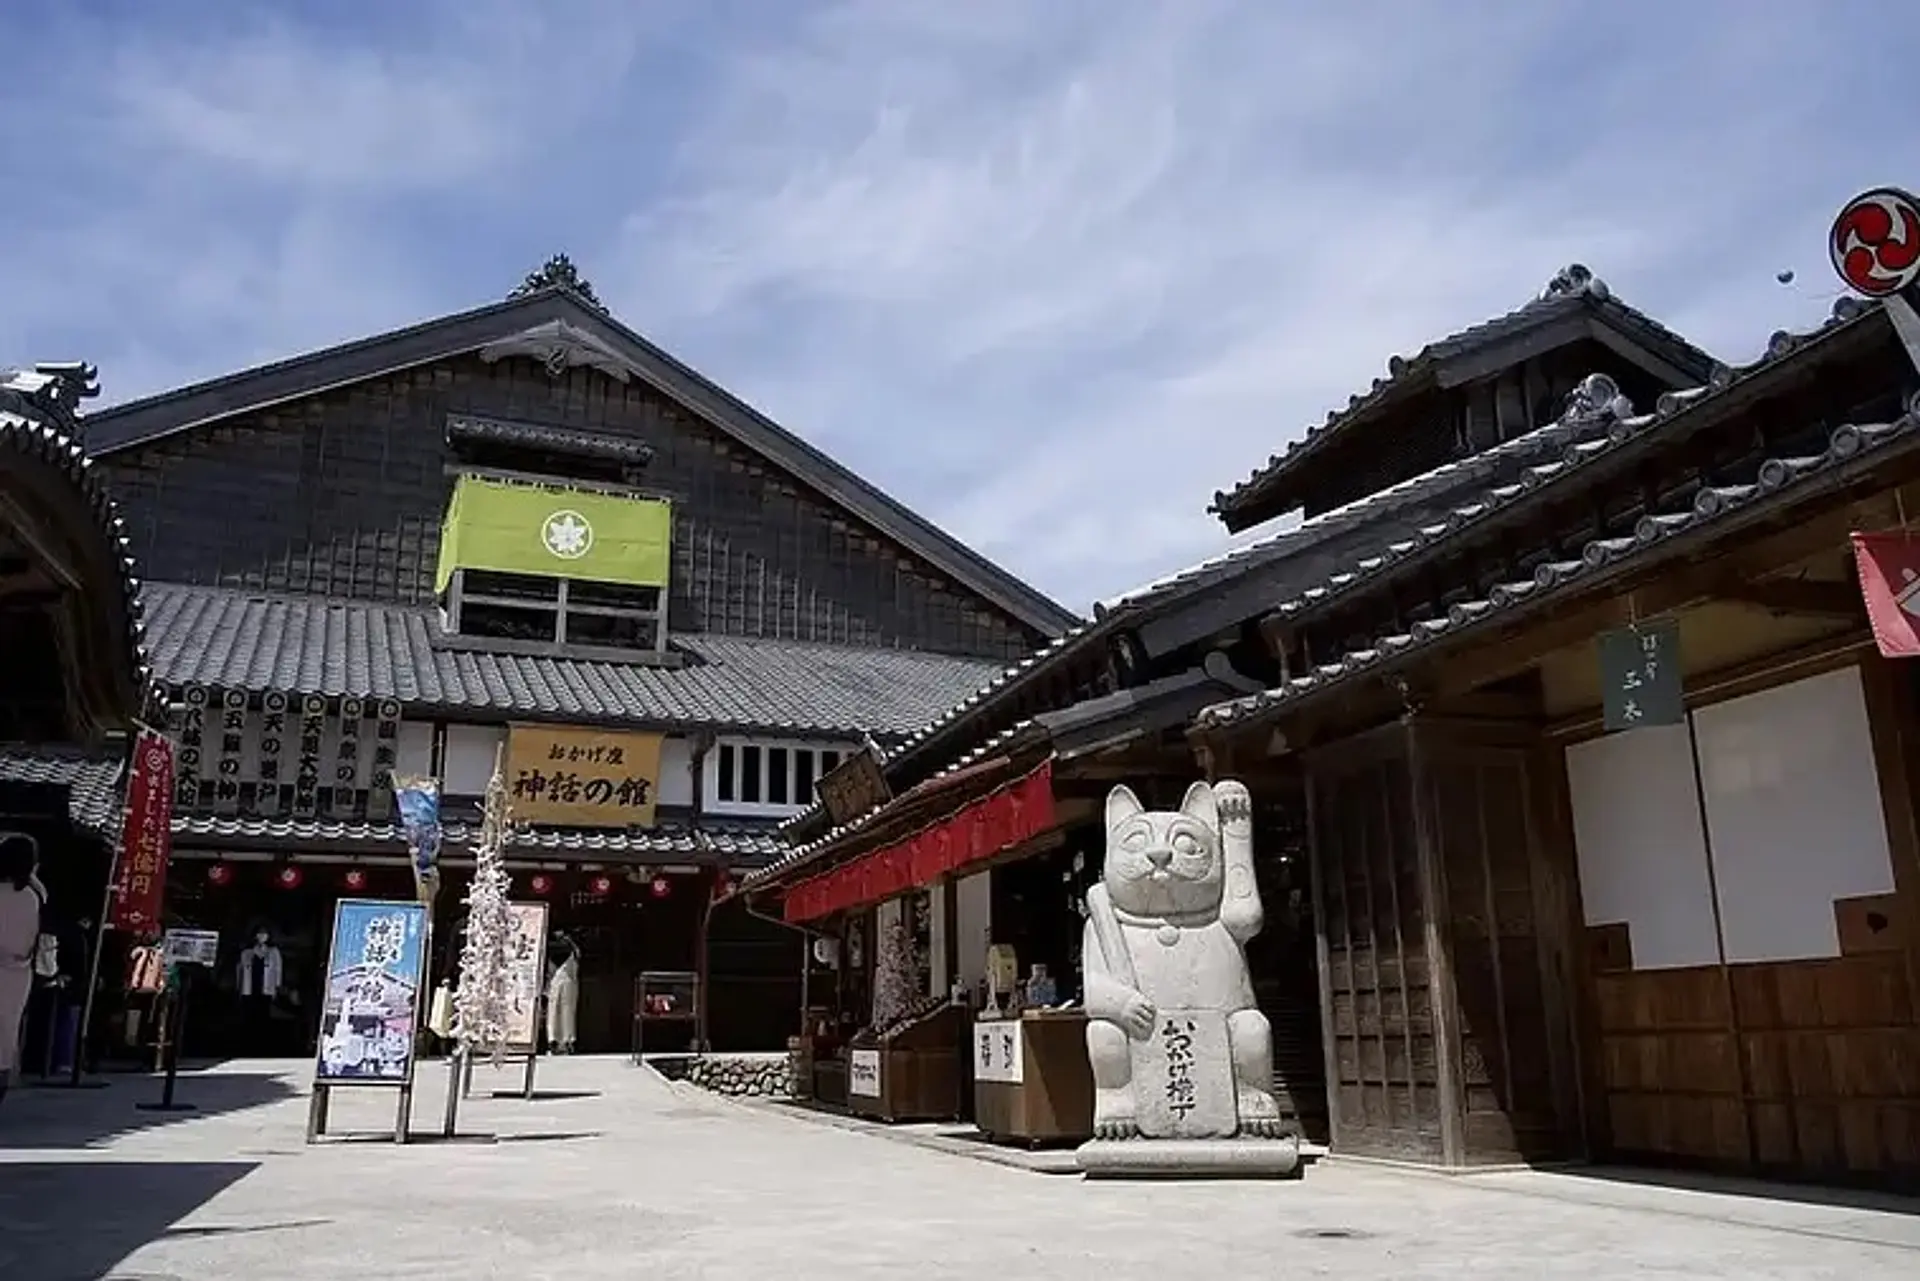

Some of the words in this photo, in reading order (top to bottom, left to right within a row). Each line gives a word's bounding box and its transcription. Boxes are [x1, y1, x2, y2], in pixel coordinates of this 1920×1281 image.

[548, 743, 625, 765] おかげ座
[512, 768, 651, 806] 神話の館
[1162, 1019, 1196, 1120] おかげ横丁
